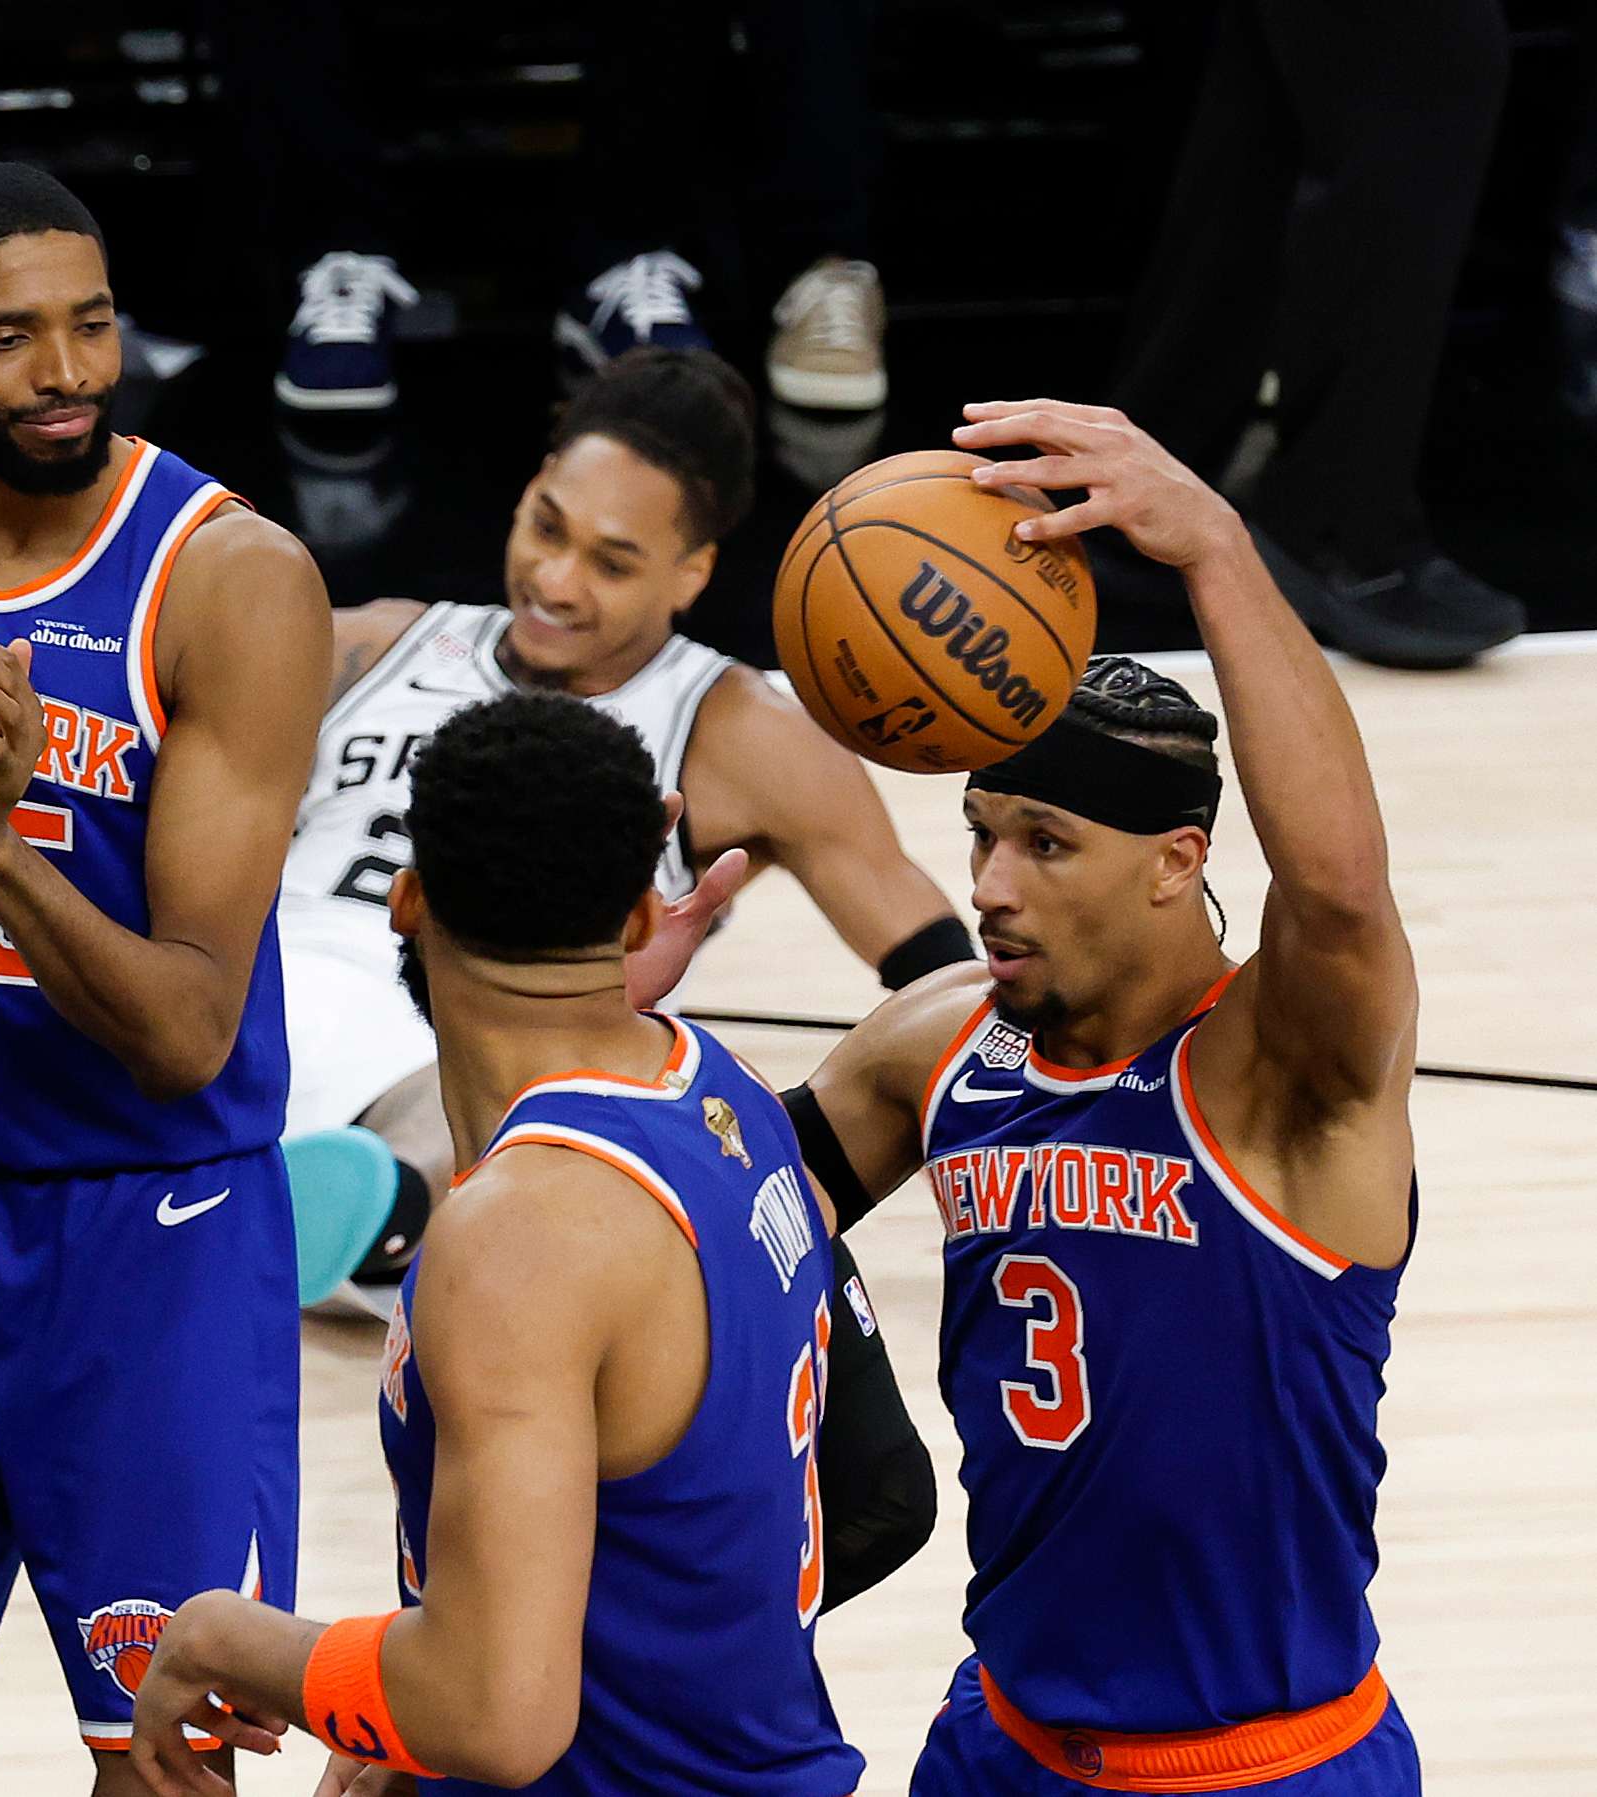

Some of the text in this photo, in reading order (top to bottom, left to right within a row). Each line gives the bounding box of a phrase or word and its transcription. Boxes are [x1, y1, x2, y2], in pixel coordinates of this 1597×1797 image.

[29, 628, 124, 653] abu dhabi
[899, 560, 1049, 729] Wilson
[33, 693, 140, 802] RK
[979, 1041, 1019, 1065] 250
[992, 1026, 1026, 1050] USA
[926, 1142, 1200, 1248] NEW YORK
[992, 1254, 1091, 1451] 3
